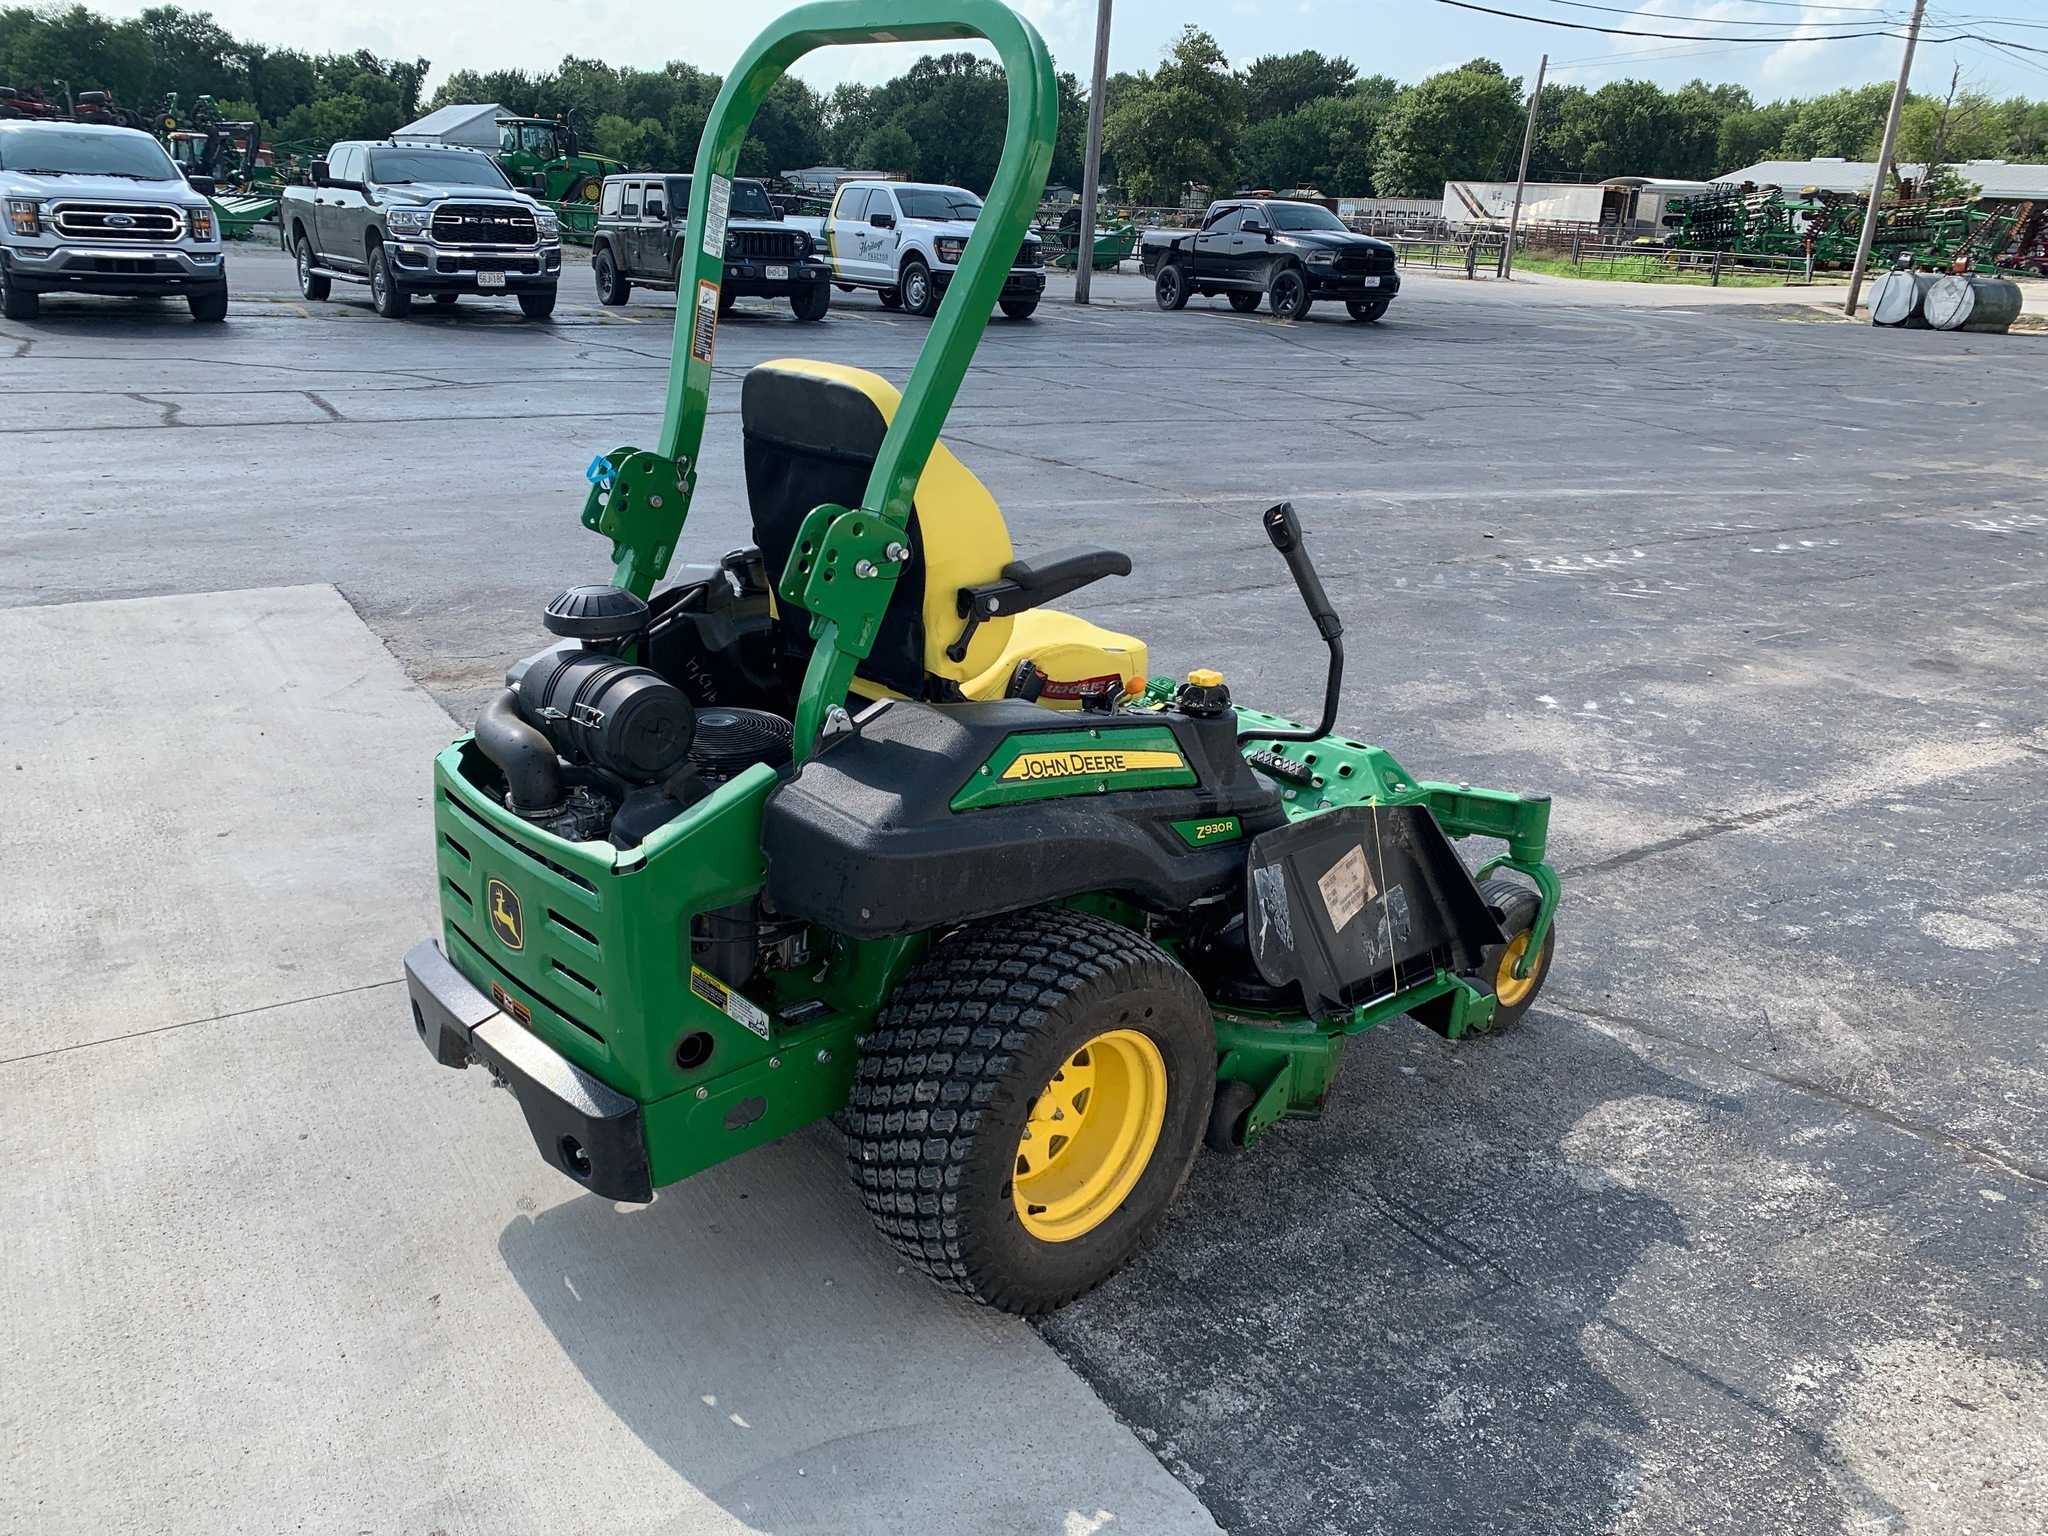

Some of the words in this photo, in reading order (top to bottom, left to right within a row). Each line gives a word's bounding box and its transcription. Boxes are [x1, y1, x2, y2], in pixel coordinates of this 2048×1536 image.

[464, 217, 509, 225] RAM
[858, 239, 884, 257] Heritage
[1021, 758, 1068, 777] JOHN
[1069, 754, 1126, 771] DEERE
[1196, 821, 1234, 840] Z930R
